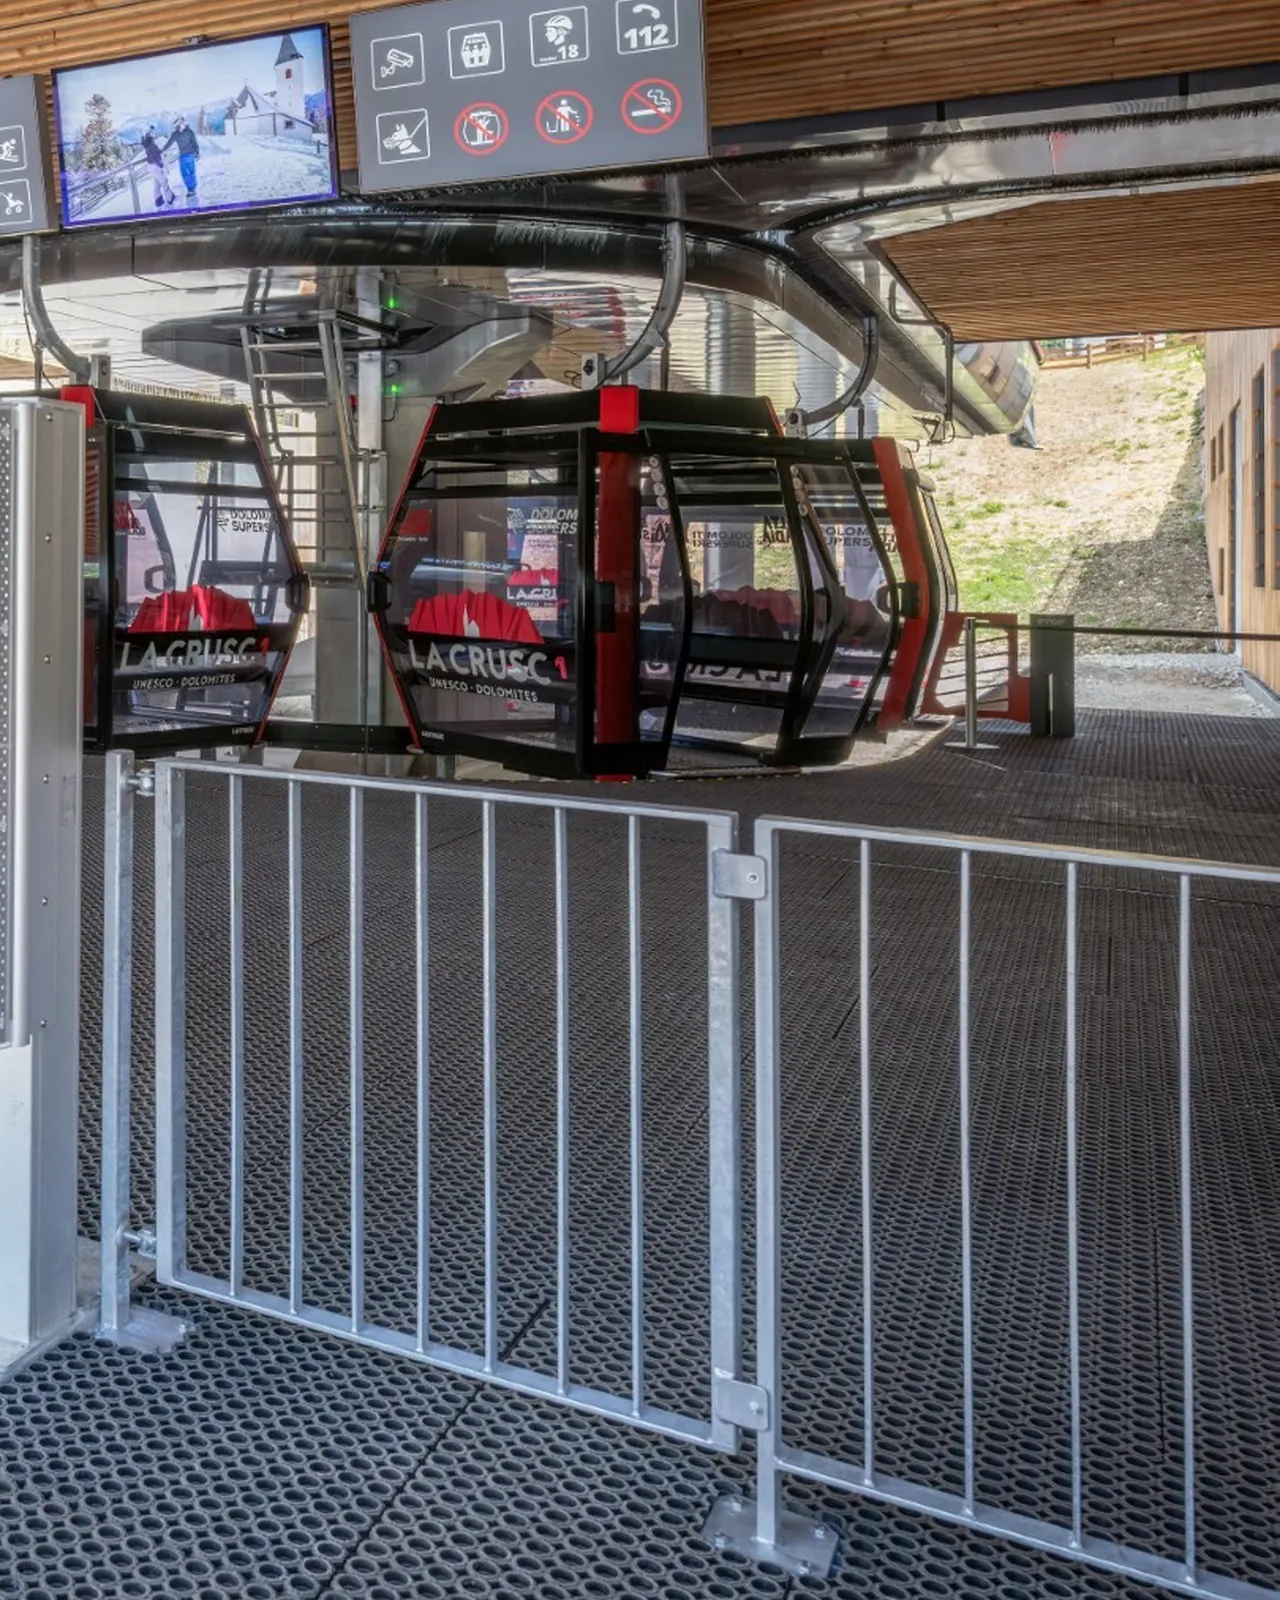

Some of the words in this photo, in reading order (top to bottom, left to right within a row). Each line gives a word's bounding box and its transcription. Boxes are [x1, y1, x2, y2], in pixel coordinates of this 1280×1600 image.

[624, 24, 669, 49] 112
[557, 43, 579, 60] 18
[231, 509, 271, 521] DOLOM
[530, 508, 579, 521] DOLOM
[231, 521, 269, 533] SUPERS
[526, 522, 578, 534] SUPERS
[120, 641, 157, 672] LA
[165, 636, 257, 670] CRUSC
[259, 637, 270, 657] 1
[408, 638, 448, 673] LA
[449, 643, 552, 686] CRUSC
[554, 655, 568, 680] 1
[132, 677, 173, 690] UNESCO
[181, 673, 236, 687] DOLOMITES
[429, 676, 468, 692] UNESCO
[476, 684, 538, 703] DOLOMITES
